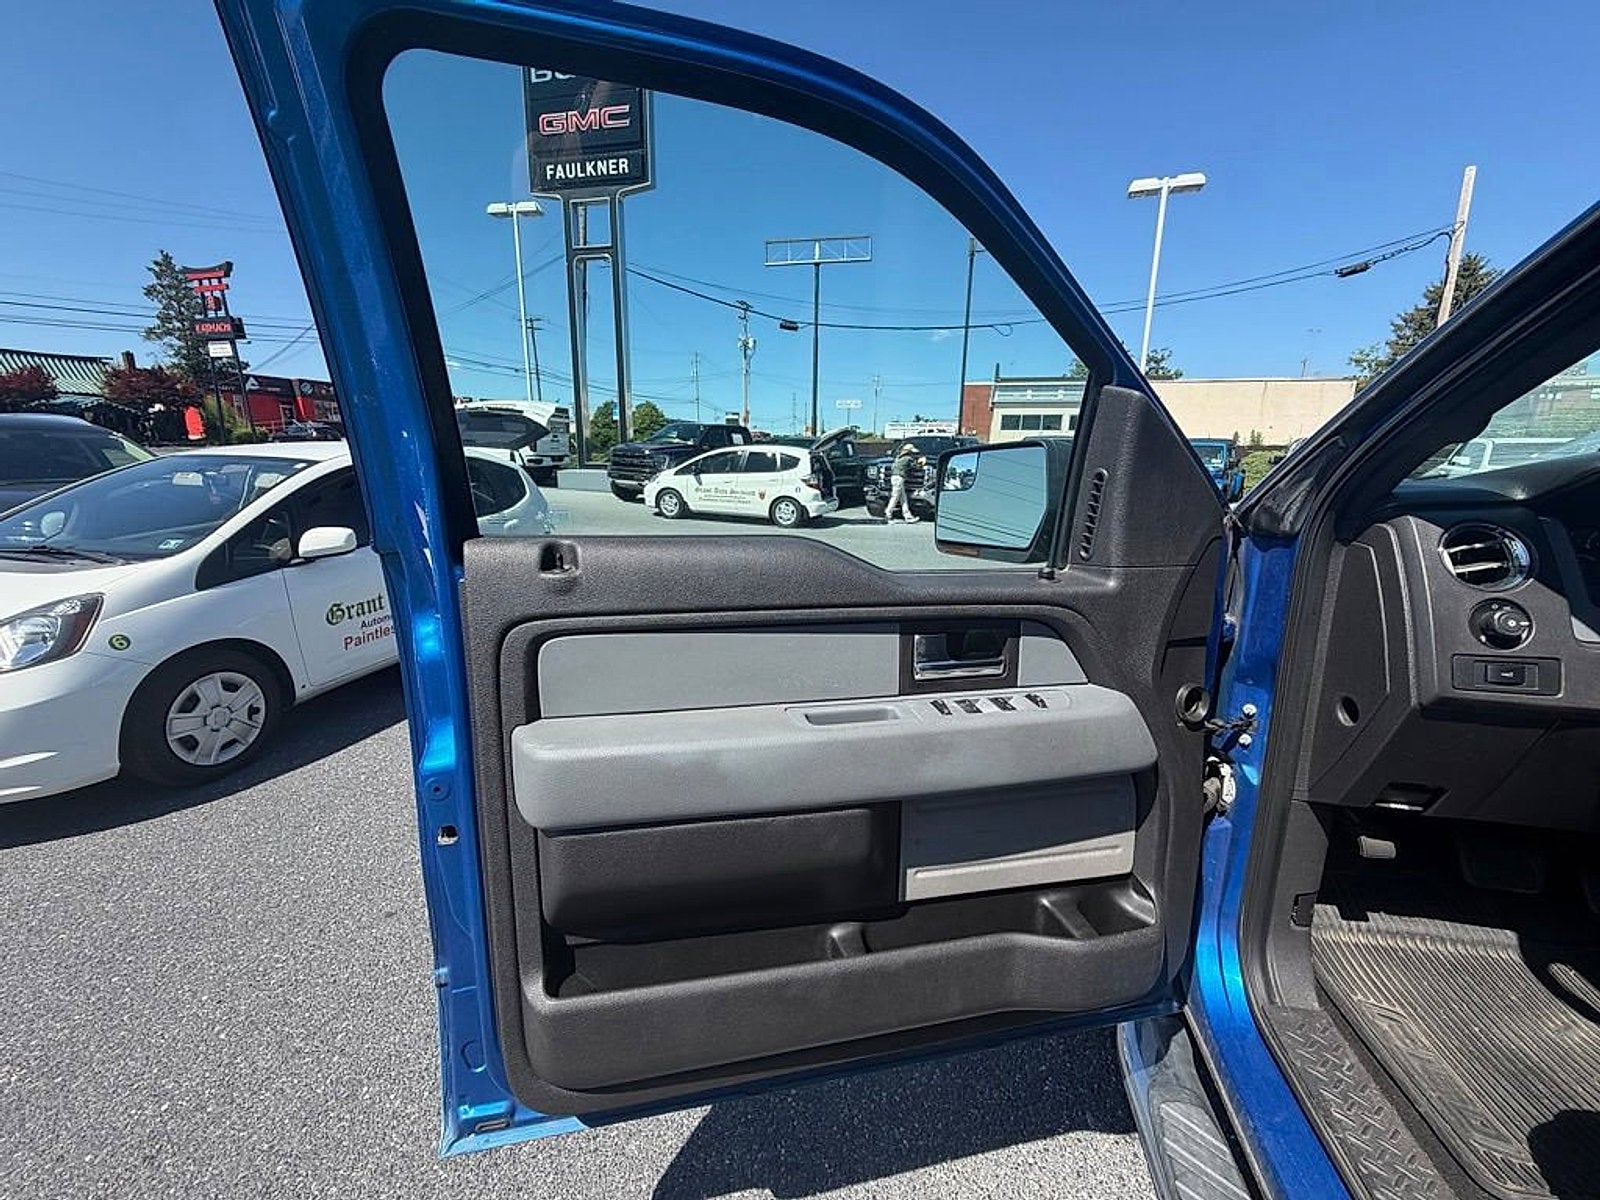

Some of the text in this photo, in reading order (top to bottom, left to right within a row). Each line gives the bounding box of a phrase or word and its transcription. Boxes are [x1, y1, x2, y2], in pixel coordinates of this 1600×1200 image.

[539, 104, 630, 135] GMC
[546, 158, 629, 180] FAULKNER
[325, 592, 385, 626] Grant
